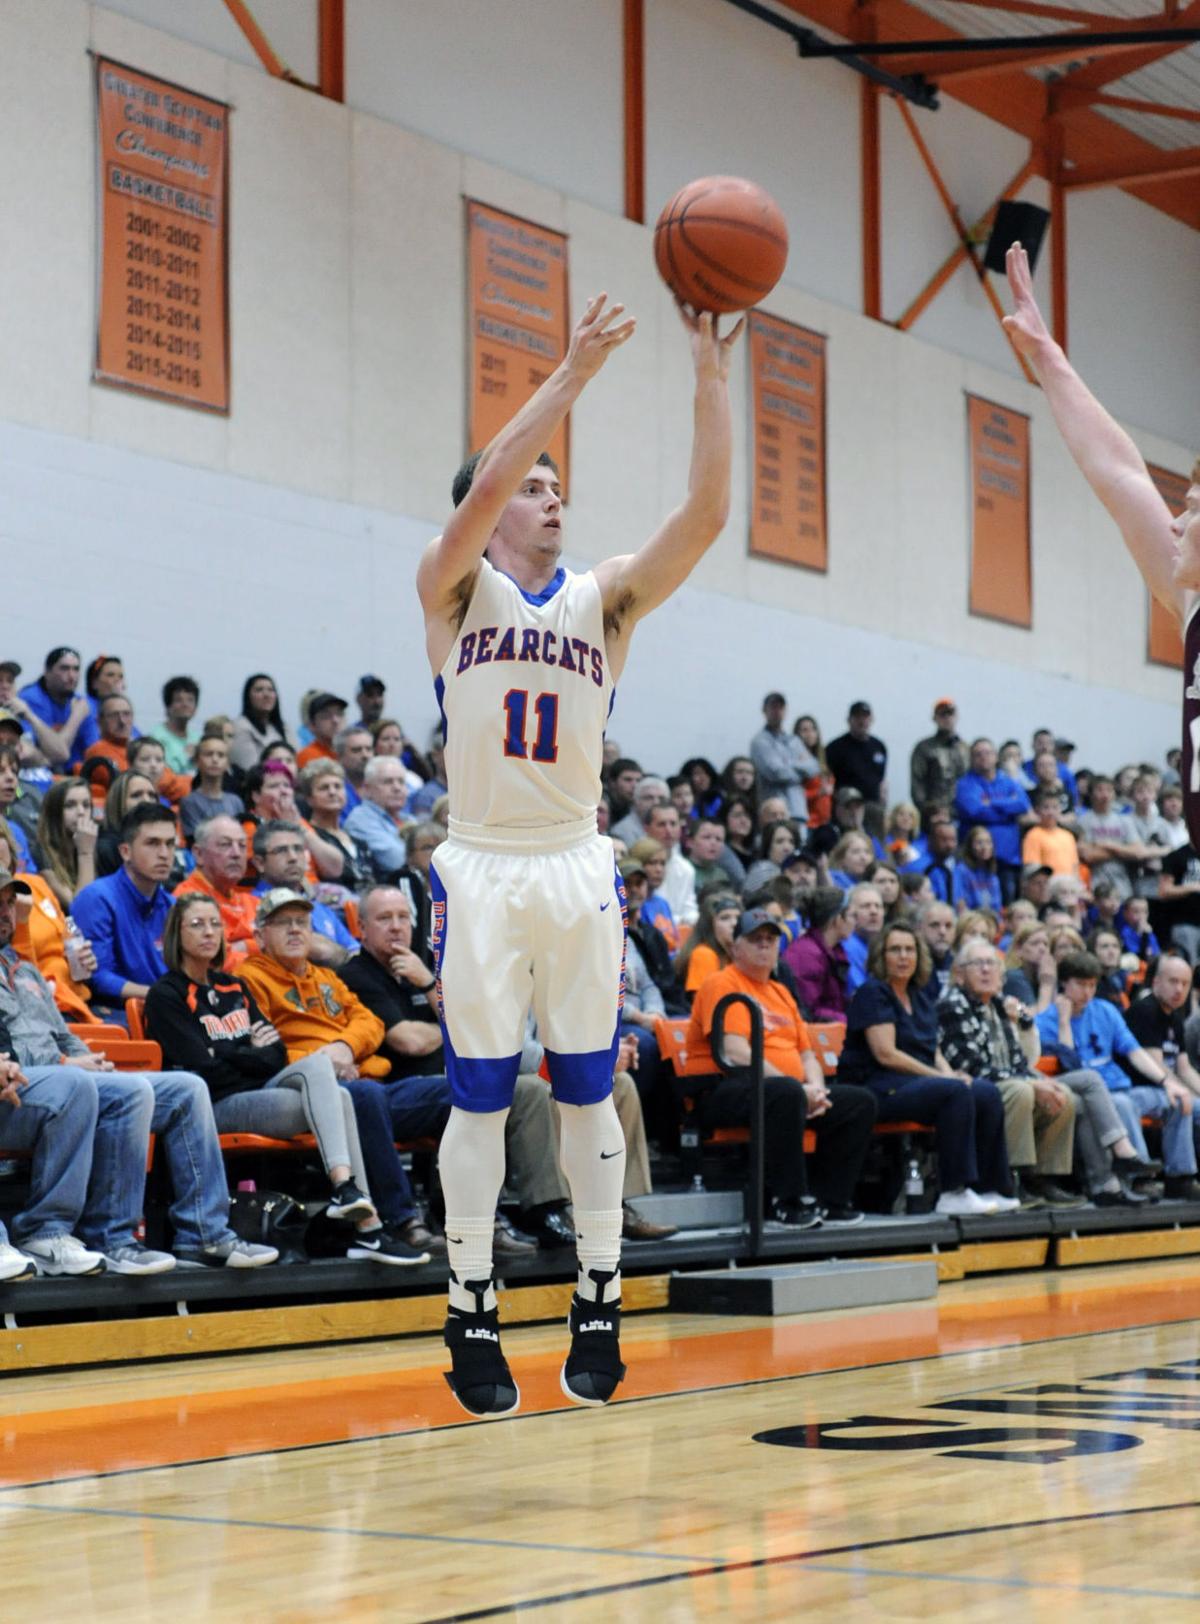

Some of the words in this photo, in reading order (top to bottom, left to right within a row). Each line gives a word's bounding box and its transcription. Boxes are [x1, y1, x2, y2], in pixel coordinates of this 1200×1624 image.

[111, 169, 214, 219] BASKETBALL
[456, 626, 603, 688] BEARCATS
[503, 688, 559, 763] 11
